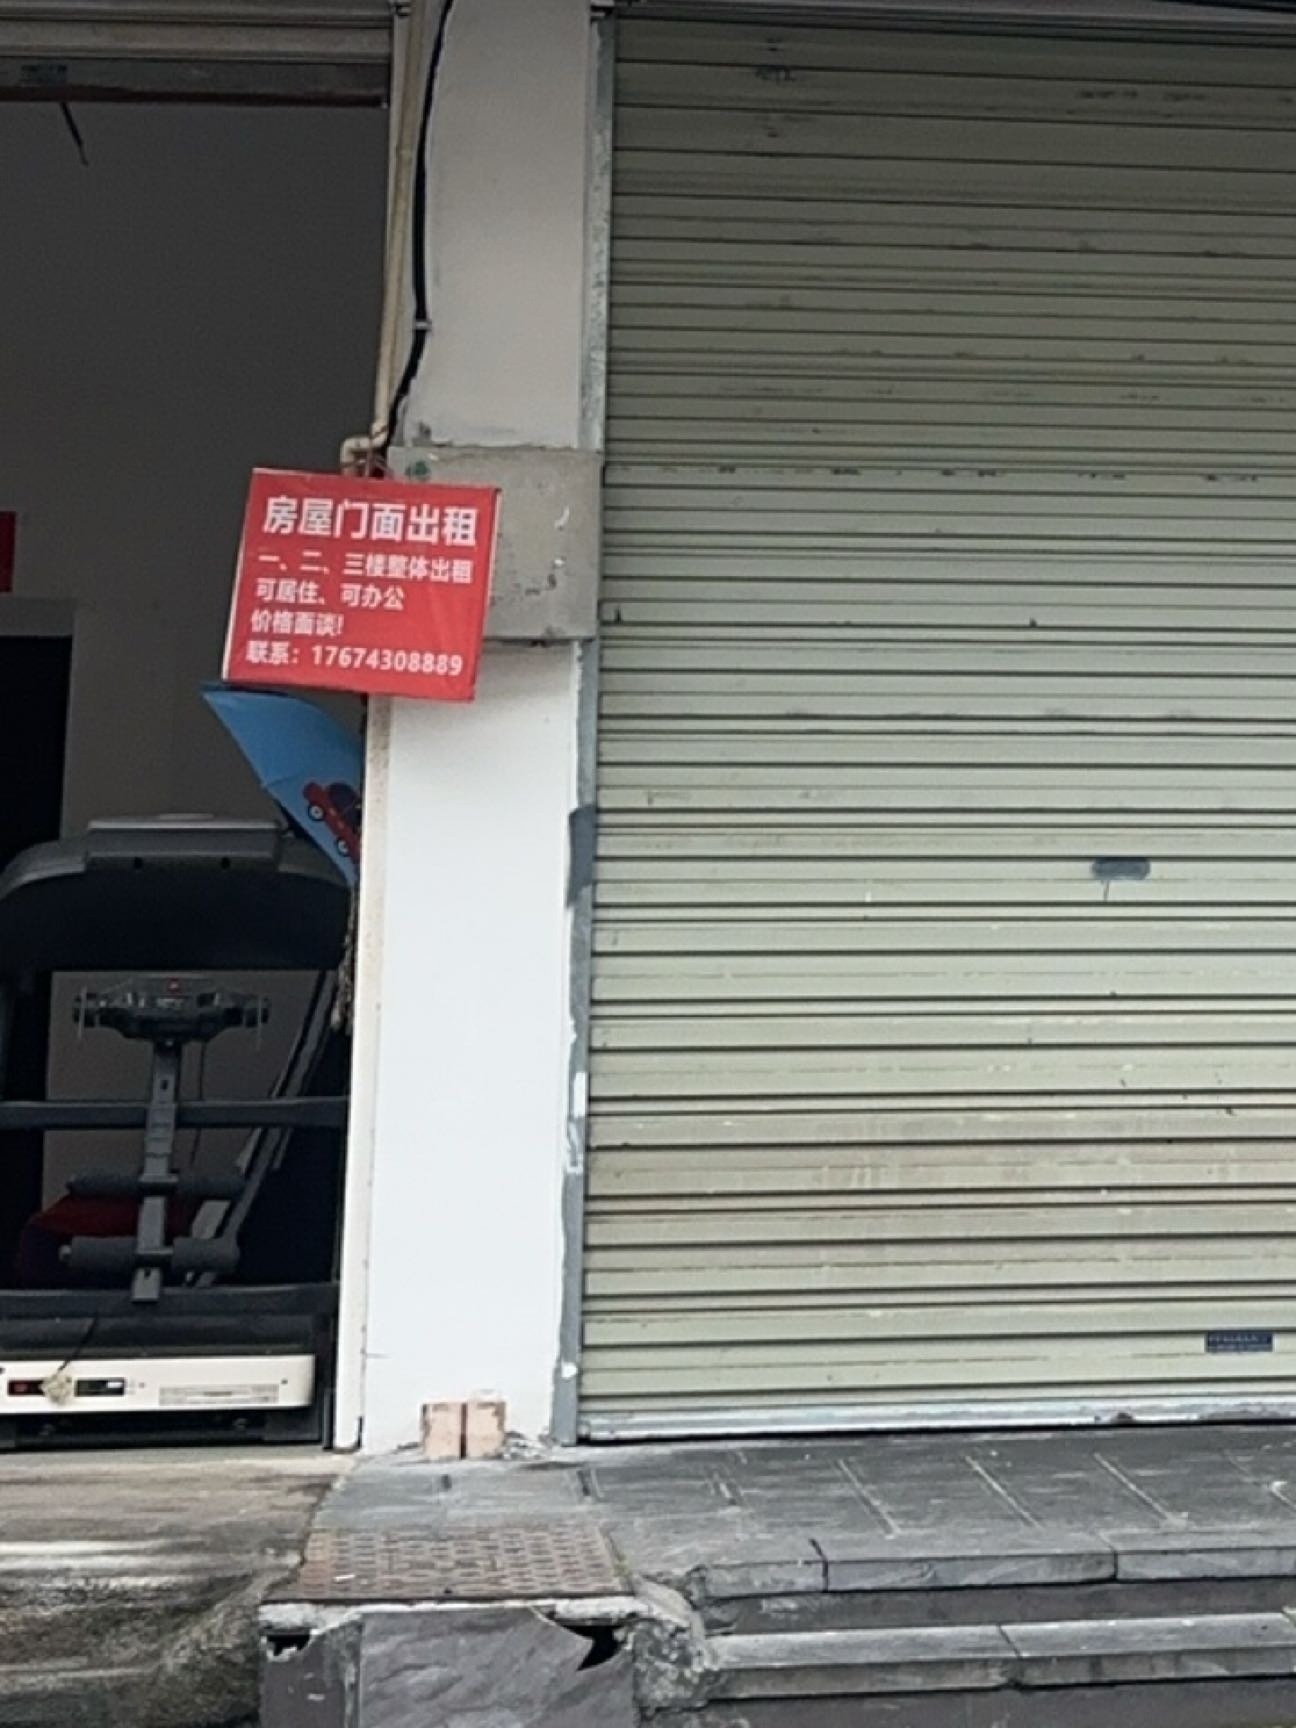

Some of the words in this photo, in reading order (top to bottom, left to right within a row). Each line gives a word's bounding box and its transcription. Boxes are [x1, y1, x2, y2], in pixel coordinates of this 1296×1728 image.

[262, 495, 478, 547] 房屋门面出租
